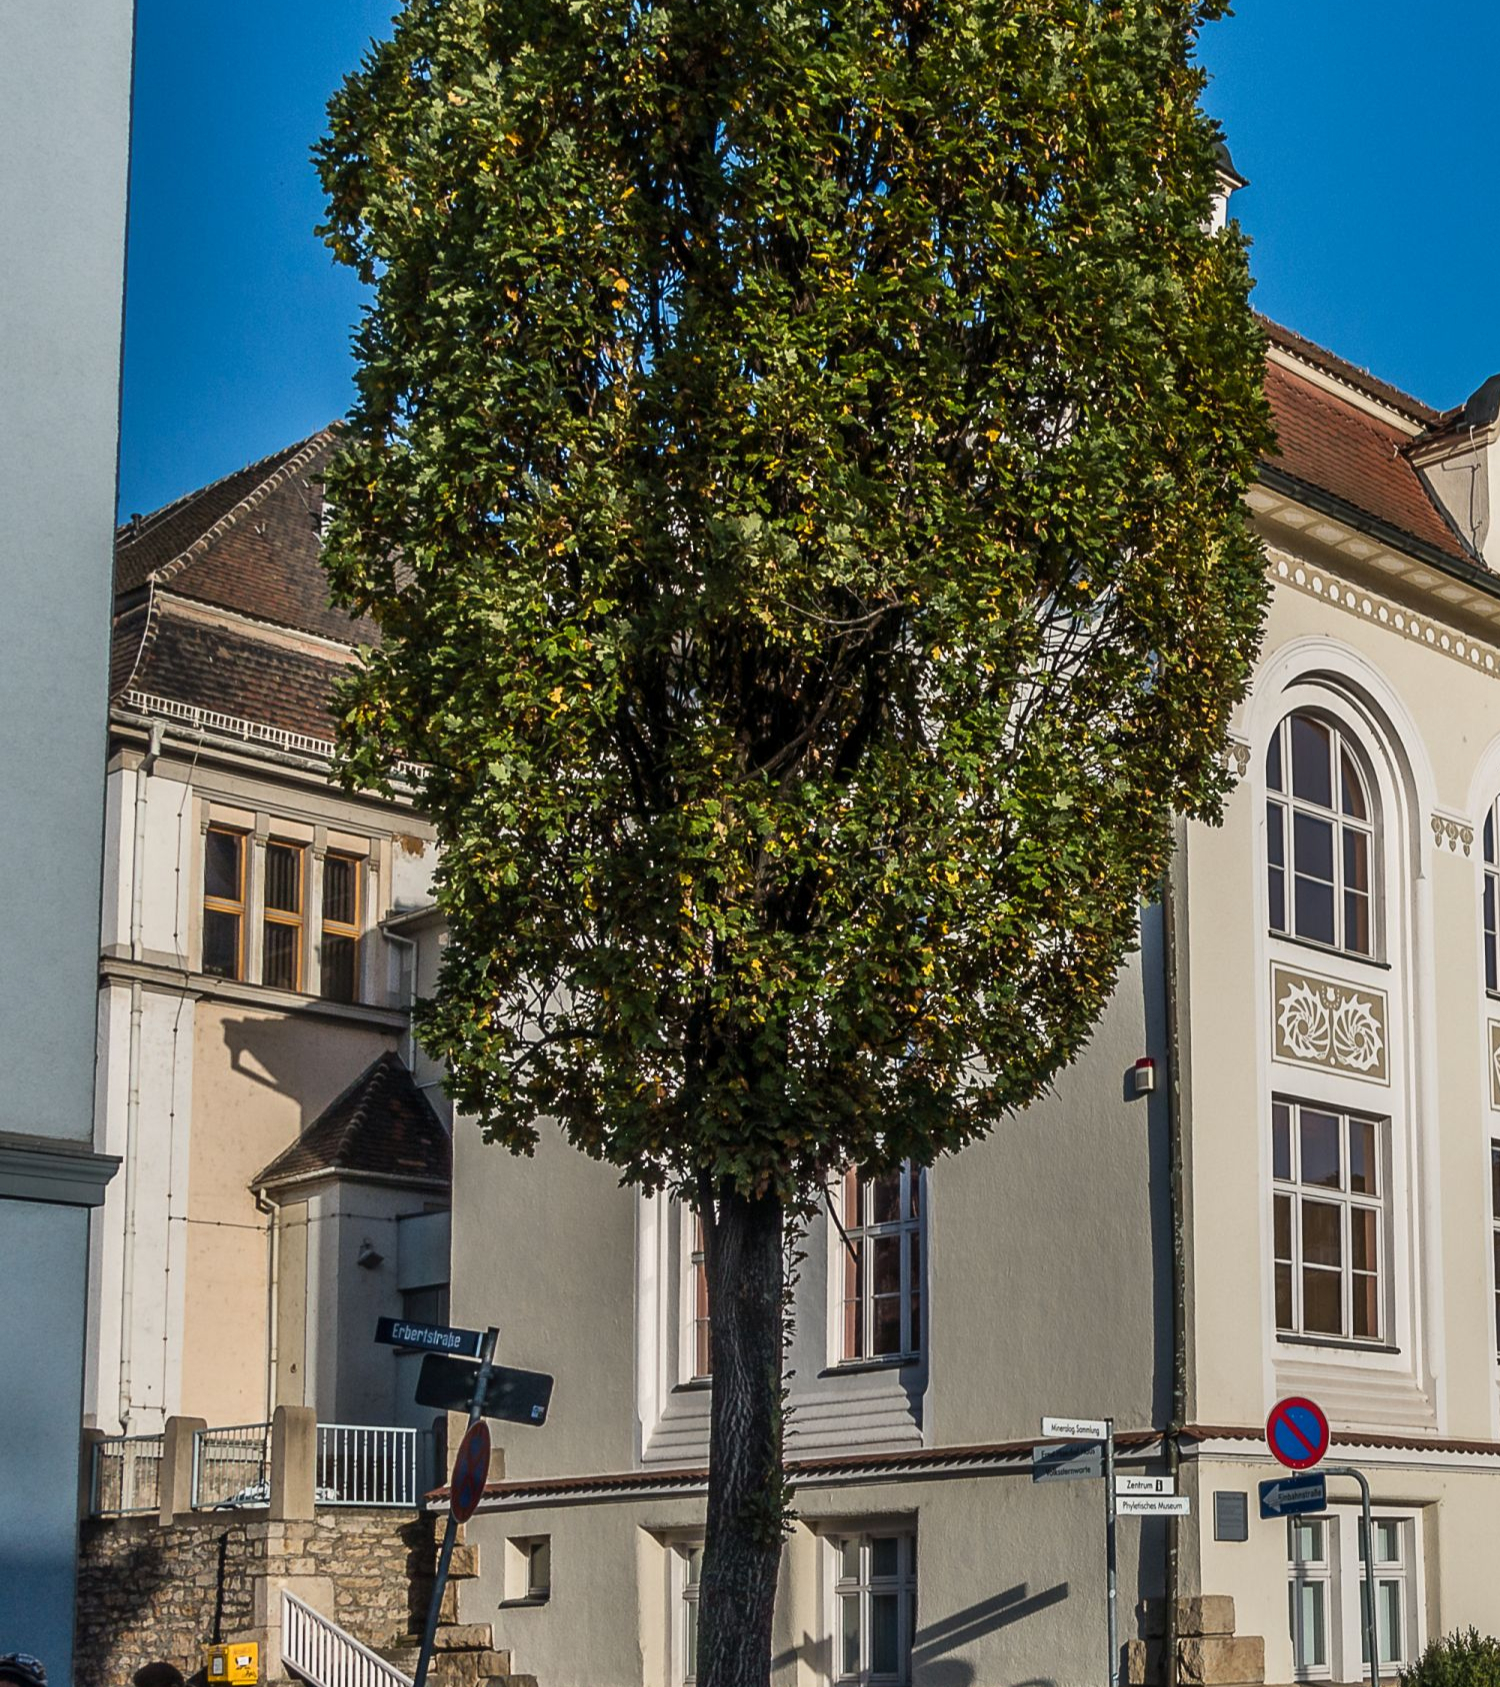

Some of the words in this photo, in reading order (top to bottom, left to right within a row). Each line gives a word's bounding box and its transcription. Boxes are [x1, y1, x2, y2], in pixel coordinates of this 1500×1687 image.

[392, 1322, 461, 1348] Erbertstraße
[1076, 1424, 1100, 1437] Sammlung
[1126, 1480, 1153, 1490] Zentrum
[1278, 1488, 1322, 1501] Einbahnstraße
[1122, 1501, 1157, 1511] Phyletisches
[1158, 1502, 1182, 1510] Museum
